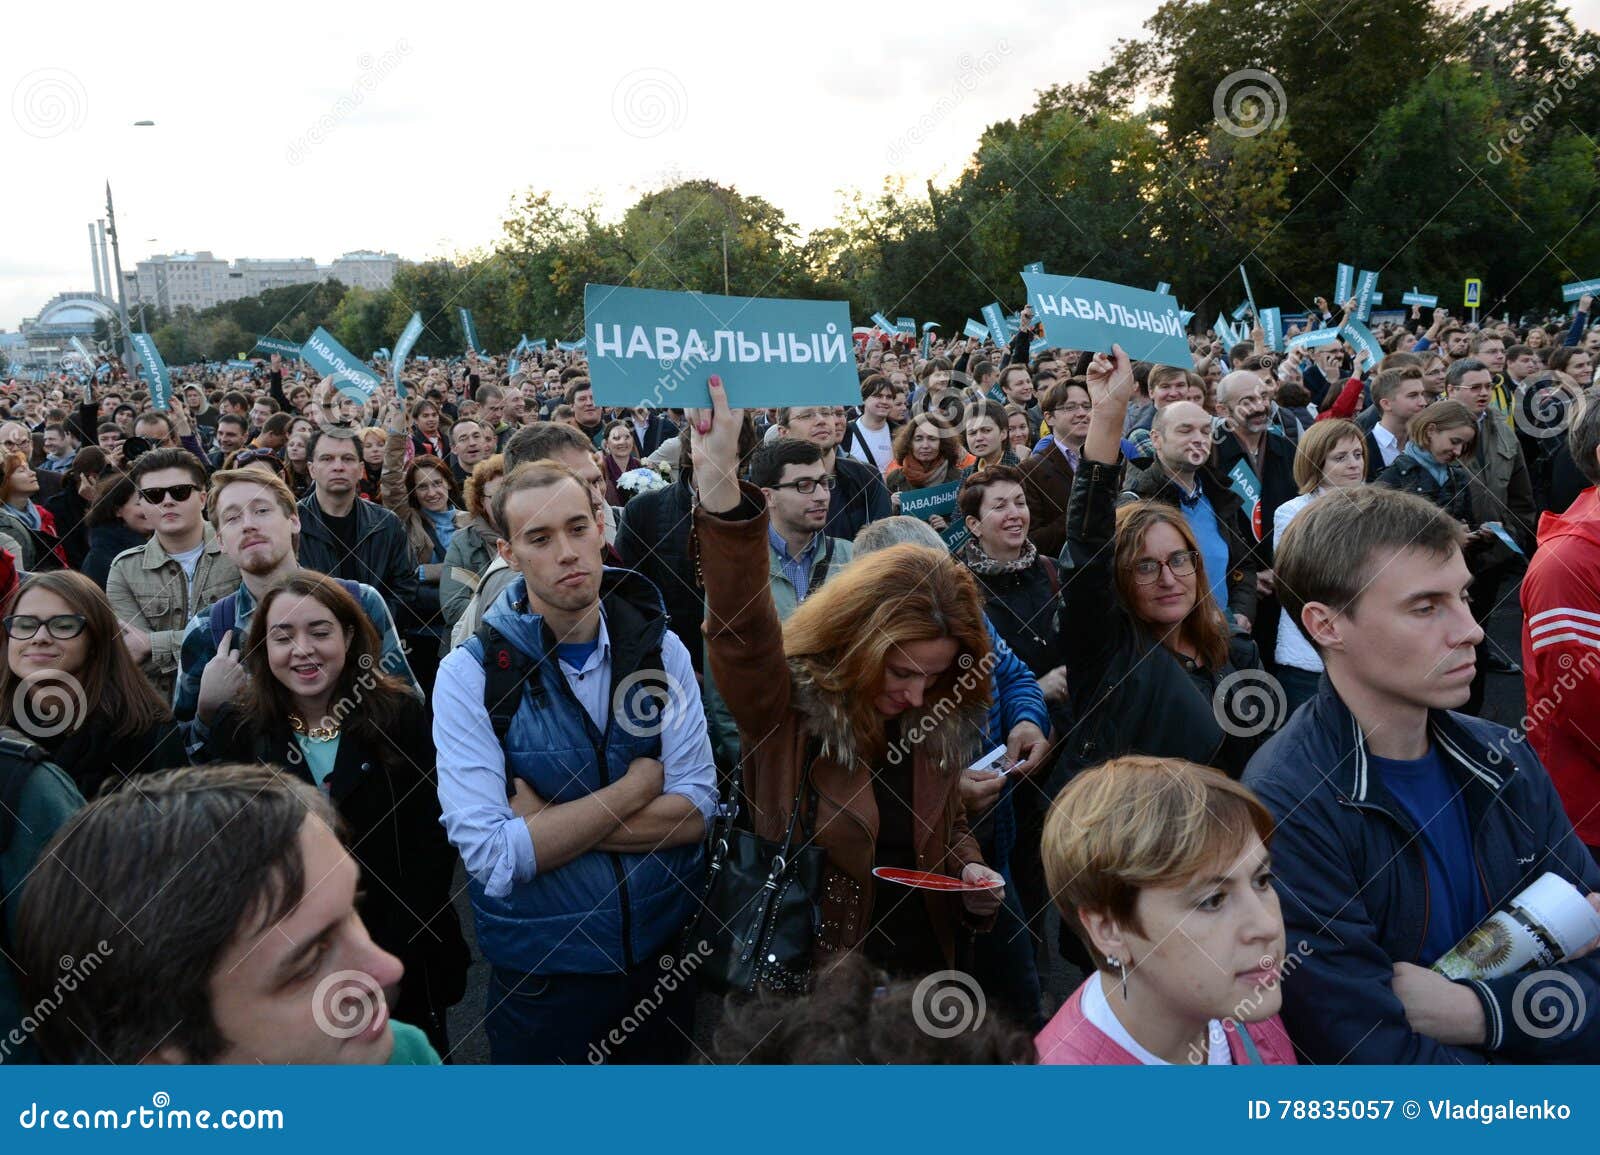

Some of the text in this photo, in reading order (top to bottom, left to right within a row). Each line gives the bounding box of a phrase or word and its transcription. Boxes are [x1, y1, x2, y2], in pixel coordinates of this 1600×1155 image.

[1036, 293, 1184, 338] НАВАЛЬНЫЙ
[308, 336, 376, 395] НАВАЛЬНЫЙ
[594, 322, 848, 363] НАВАЛЬНЫЙ
[134, 335, 166, 409] НАВАЛЬНЫЙ
